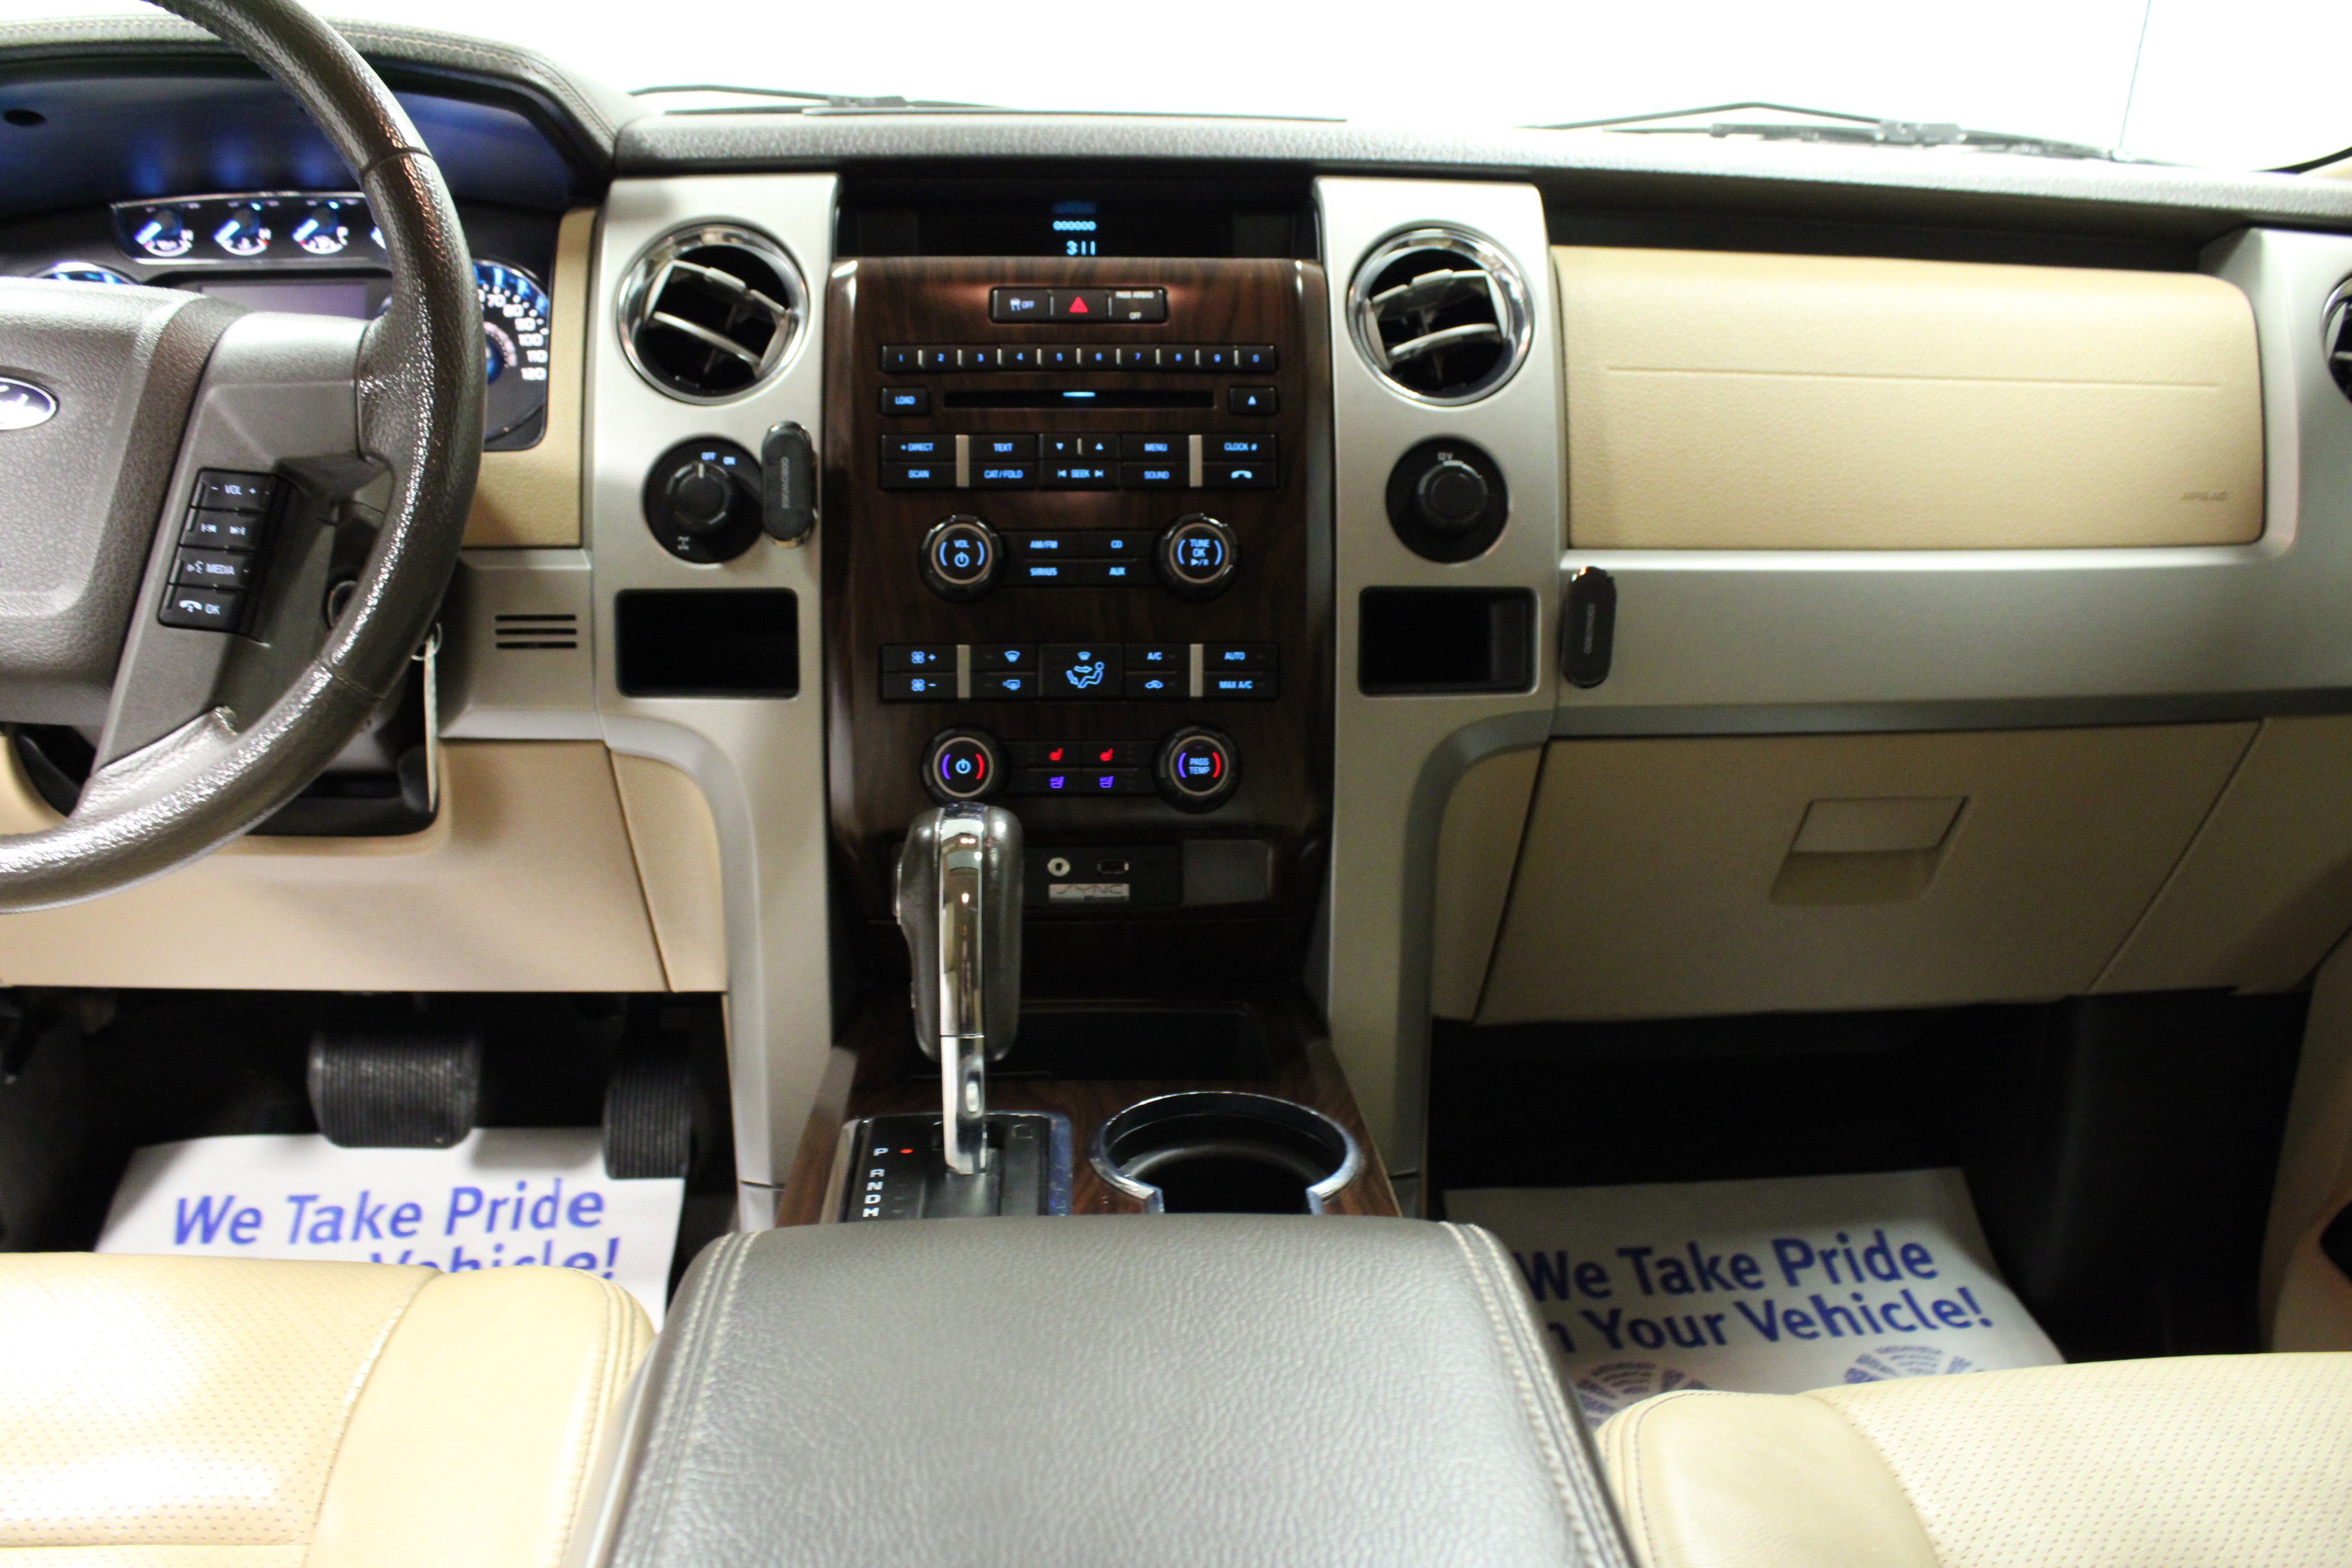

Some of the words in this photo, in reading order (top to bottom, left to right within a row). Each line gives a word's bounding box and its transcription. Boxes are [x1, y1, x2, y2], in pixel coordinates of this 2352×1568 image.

[937, 354, 945, 362] 2
[1017, 352, 1024, 361] 4
[1135, 352, 1141, 361] 7
[894, 396, 916, 405] LOAD
[993, 443, 1014, 452] TEXT
[1144, 443, 1168, 452] MENU
[1224, 442, 1249, 452] CLOCK
[907, 469, 930, 479] SCAN
[1070, 469, 1091, 478] SEEK
[1144, 471, 1170, 479] SOUND
[953, 540, 970, 549] VOL
[1030, 540, 1059, 549] AM/FM
[1110, 540, 1123, 549] CD
[1190, 538, 1211, 548] TUNE
[1192, 548, 1206, 558] OK
[205, 563, 236, 576] MEDIA
[1030, 567, 1058, 576] SIRIUS
[1109, 567, 1126, 576] AUX
[1147, 652, 1163, 661] A/C
[1224, 651, 1246, 661] AUTO
[1238, 680, 1253, 690] A/C
[873, 1147, 890, 1157] P
[868, 1168, 886, 1178] R
[866, 1181, 884, 1191] N
[864, 1194, 881, 1204] D
[174, 1194, 263, 1244] We
[286, 1190, 422, 1244] Take
[444, 1178, 605, 1235] Pride
[862, 1207, 880, 1218] M
[1513, 1250, 1612, 1302] We
[1617, 1241, 1765, 1297] Take
[1773, 1229, 1939, 1288] Pride
[1579, 1306, 1729, 1351] Your
[1734, 1286, 1994, 1343] Vehicle!
